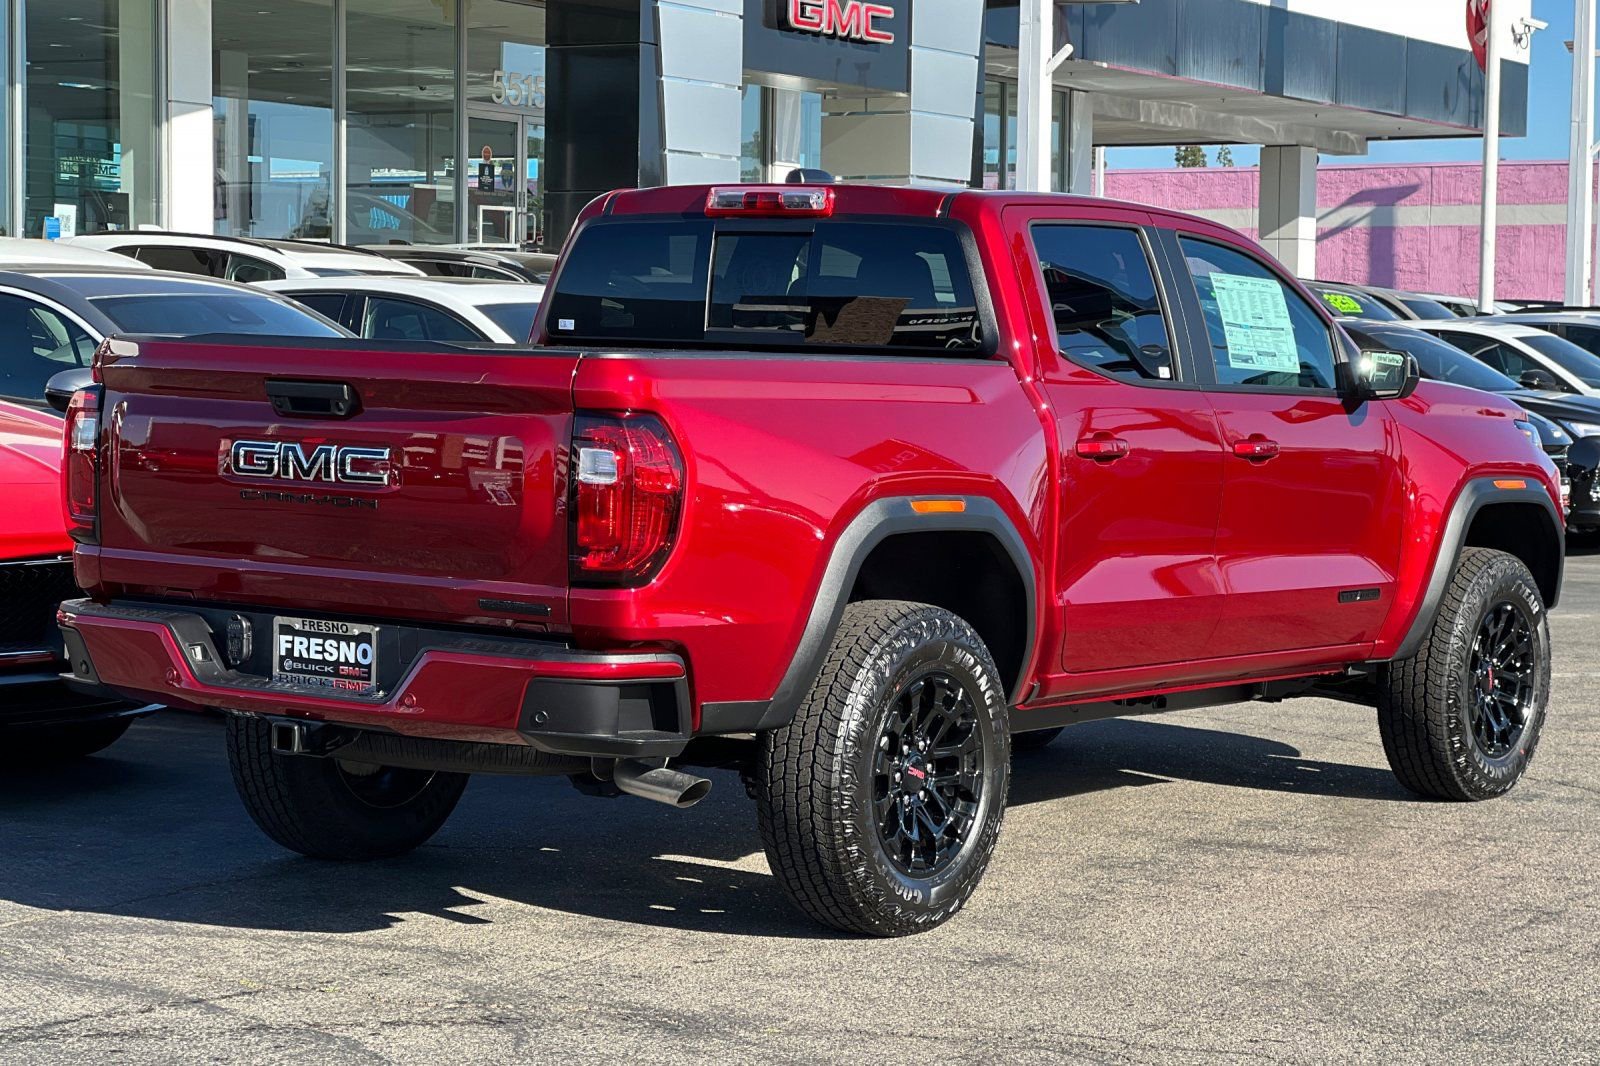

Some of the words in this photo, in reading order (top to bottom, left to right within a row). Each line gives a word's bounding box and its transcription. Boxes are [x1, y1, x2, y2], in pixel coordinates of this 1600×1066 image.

[787, 0, 895, 44] GMC
[491, 69, 546, 109] 5515
[231, 439, 391, 486] GMC
[239, 487, 379, 510] CANYON
[301, 619, 349, 634] FRESNO
[279, 634, 373, 665] FRESNO
[292, 661, 335, 673] BUICK
[338, 665, 369, 677] GMC
[952, 645, 1005, 750] WRANGLER
